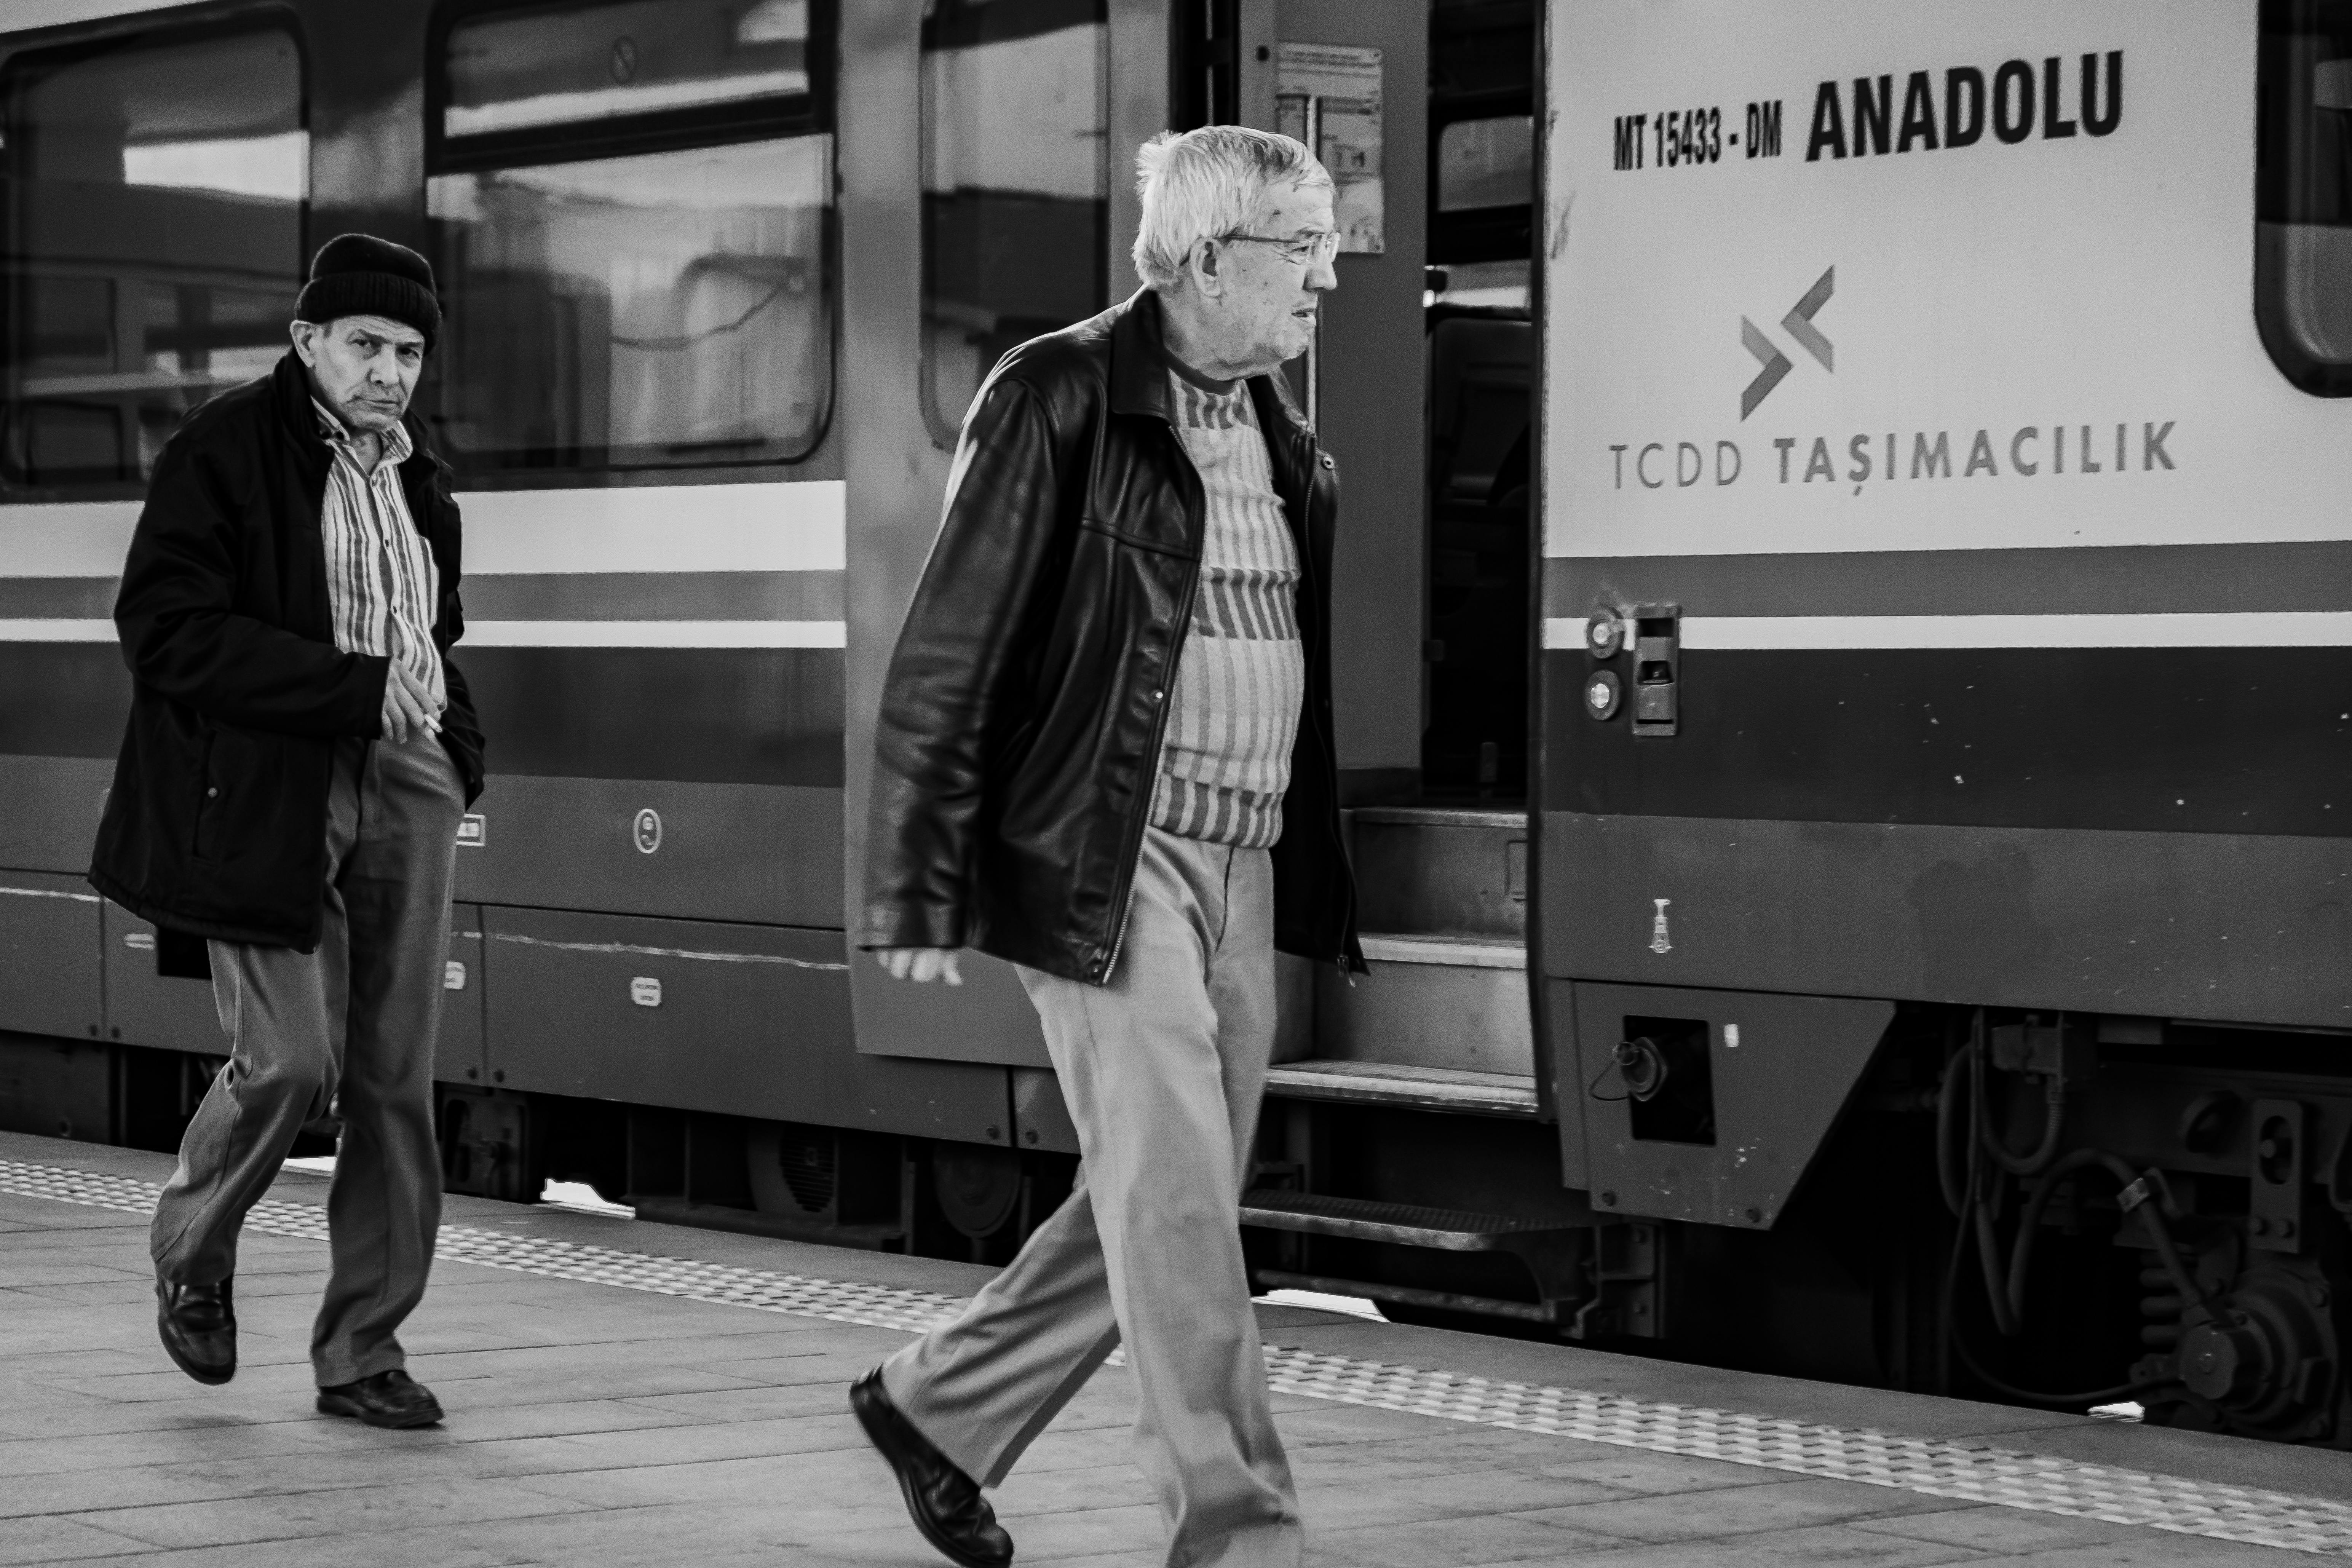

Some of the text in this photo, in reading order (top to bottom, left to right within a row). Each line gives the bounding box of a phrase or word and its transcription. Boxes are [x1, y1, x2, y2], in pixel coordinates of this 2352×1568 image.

[1614, 114, 1647, 171] MT
[1654, 107, 1721, 167] 15433
[1746, 99, 1782, 160] DM
[1805, 49, 2123, 163] ANADOLU
[1609, 420, 2177, 497] TCDD TAŞIMACILIK
